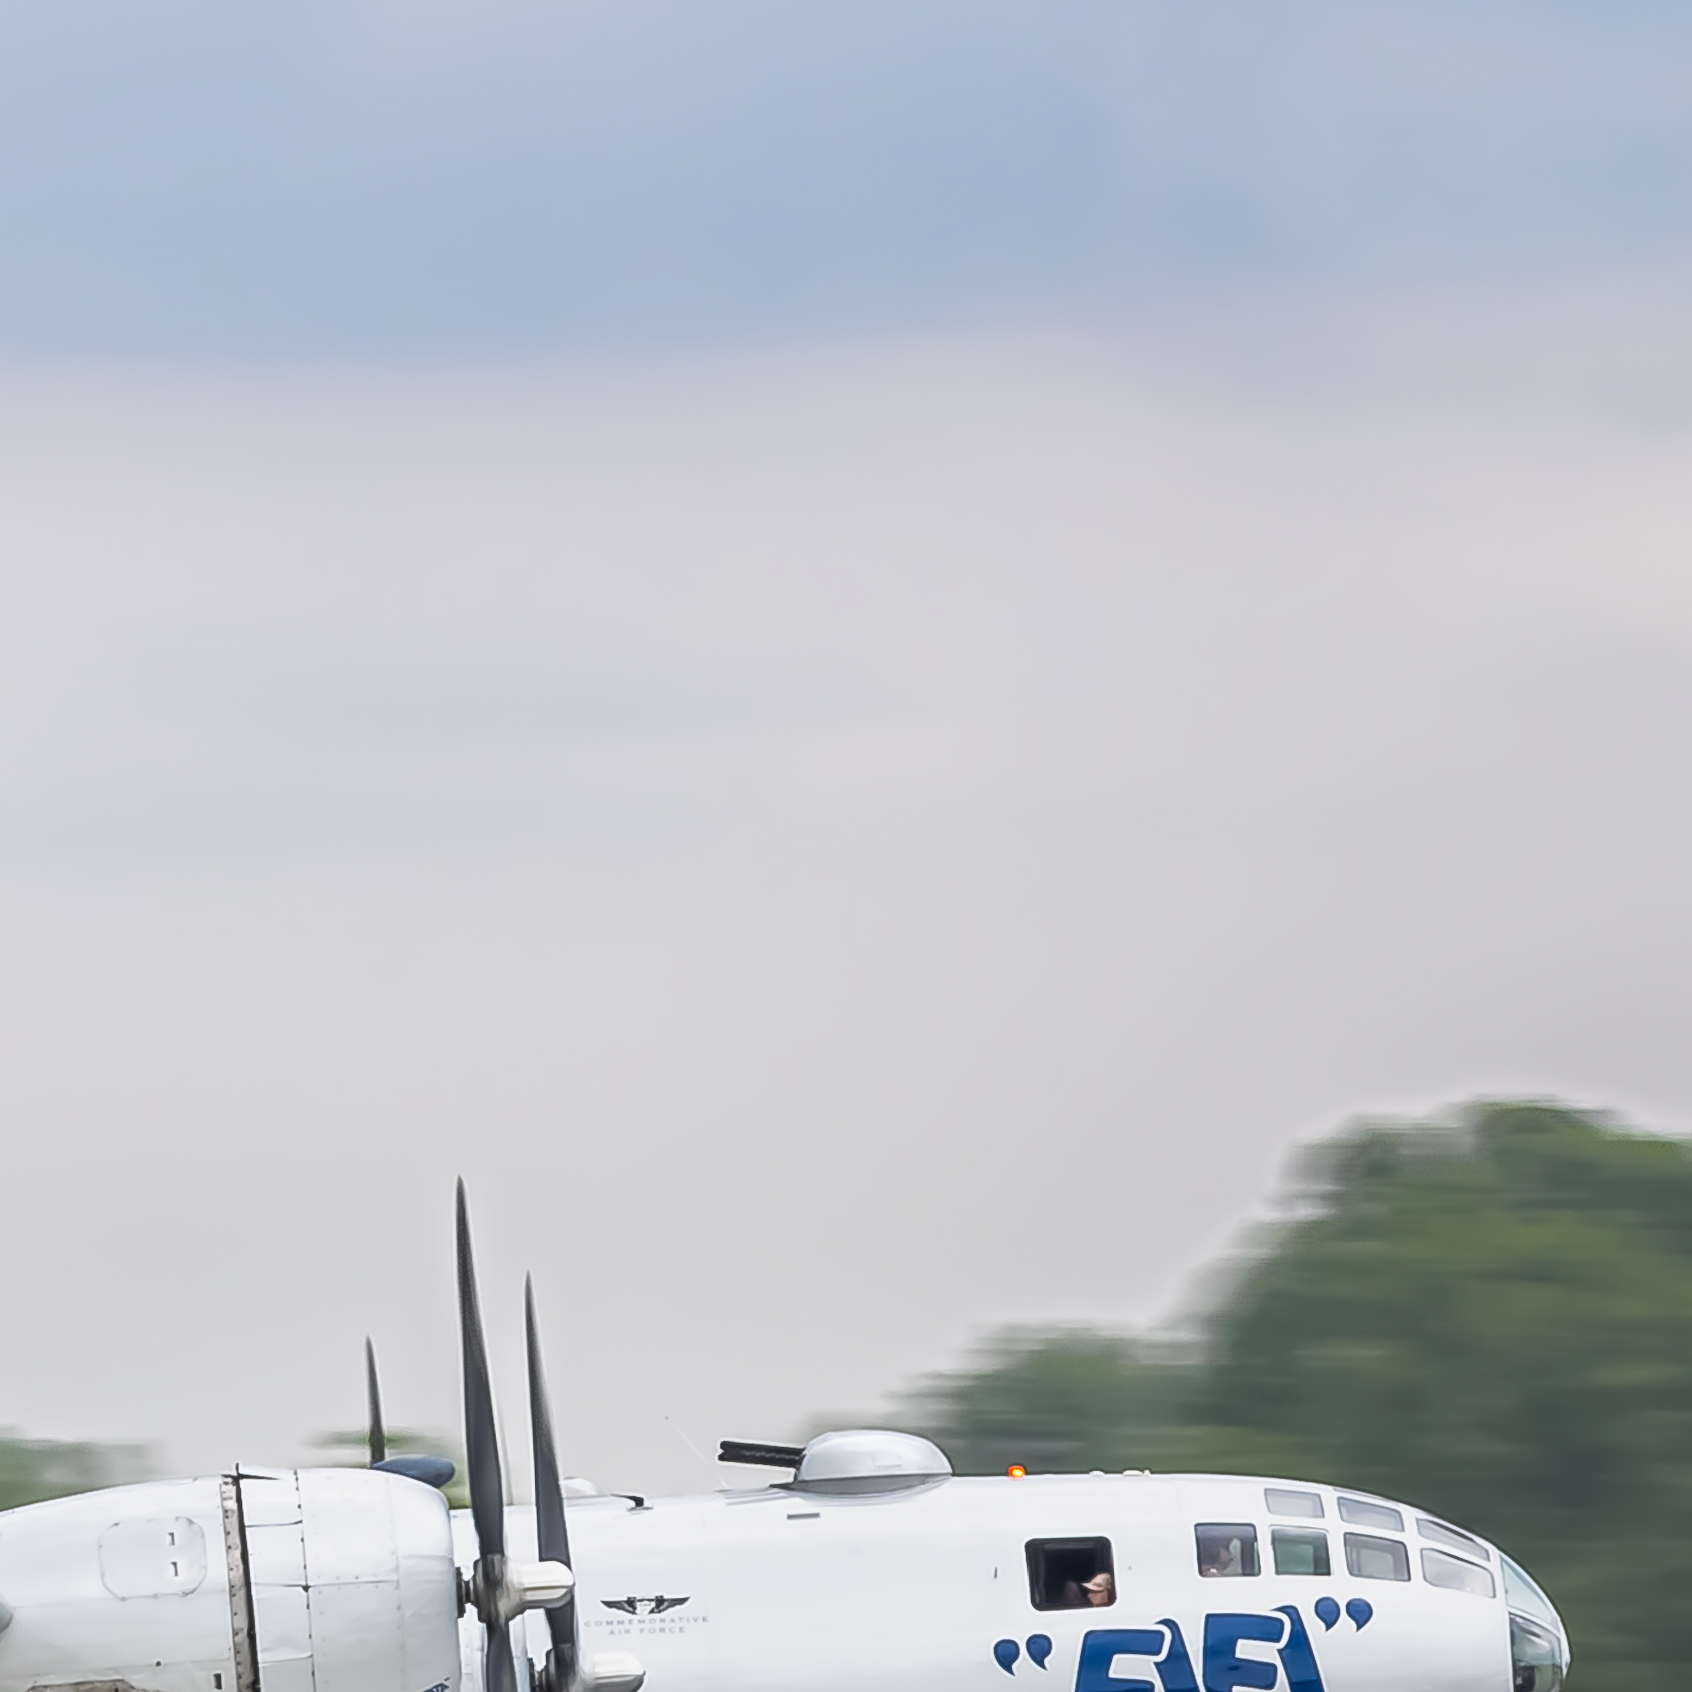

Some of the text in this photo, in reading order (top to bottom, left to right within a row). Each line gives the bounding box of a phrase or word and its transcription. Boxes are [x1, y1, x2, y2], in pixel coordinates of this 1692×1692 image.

[583, 1615, 710, 1627] COMMEMORATIVE
[608, 1626, 686, 1636] AIR FORCE
